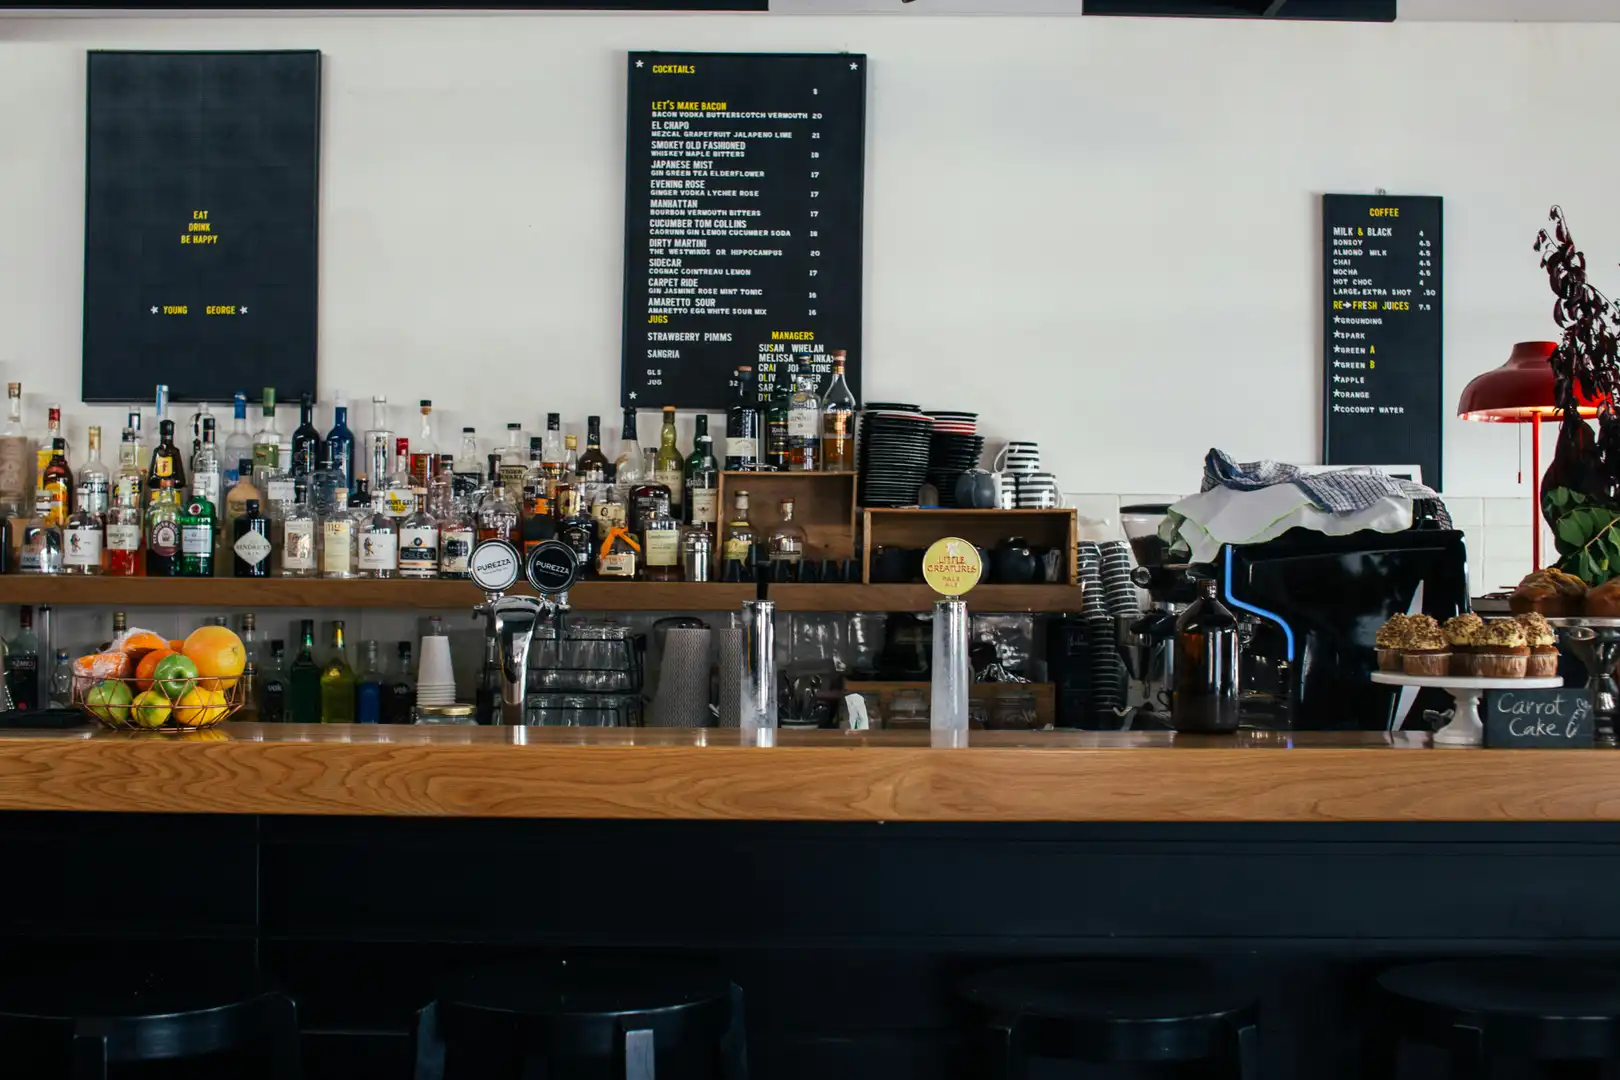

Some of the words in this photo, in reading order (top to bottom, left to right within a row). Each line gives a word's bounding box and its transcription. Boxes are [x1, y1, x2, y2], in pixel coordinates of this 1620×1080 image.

[653, 65, 695, 73] COCKTAILS
[652, 100, 674, 110] LET'S
[677, 102, 699, 110] MAKE
[701, 101, 726, 111] BACON
[652, 121, 662, 129] EL
[664, 121, 689, 129] CHAPO
[652, 141, 684, 149] SMOKEY
[686, 141, 701, 149] OLD
[703, 141, 746, 150] FASHIONED
[651, 160, 691, 169] JAPANESE
[693, 160, 713, 169] MIST
[651, 180, 683, 188] EVENING
[685, 180, 705, 189] ROSE
[650, 199, 698, 208] MANHATTAN
[194, 211, 208, 219] EAT
[1370, 208, 1399, 217] COFFEE
[189, 223, 210, 231] DRINK
[650, 219, 692, 228] CUCUMBER
[694, 219, 712, 229] TOM
[714, 220, 747, 228] COLLINS
[1333, 227, 1353, 236] MILK
[1367, 227, 1392, 237] BLACK
[181, 235, 190, 244] BE
[193, 235, 217, 244] HAPPY
[649, 239, 672, 247] DIRTY
[674, 239, 706, 248] MARTINI
[649, 258, 682, 267] SIDECAR
[648, 278, 678, 287] CARPET
[681, 278, 698, 287] RIDE
[648, 298, 690, 306] AMARETTO
[695, 298, 716, 307] SOUR
[1382, 301, 1409, 311] JUICES
[164, 306, 187, 314] YOUNG
[206, 306, 235, 314] GEORGE
[648, 315, 668, 323] JUGS
[648, 332, 700, 341] STRAWBERRY
[704, 333, 732, 341] PIMMS
[772, 331, 814, 340] MANAGERS
[759, 344, 784, 353] SUSAN
[791, 344, 824, 353] WHELAN
[648, 350, 679, 358] SANGRIA
[759, 354, 794, 362] MELISSA
[758, 364, 776, 372] CRAI
[1379, 406, 1404, 414] WATER
[476, 558, 511, 572] PUREZZA
[937, 556, 965, 565] LITTLE
[535, 560, 569, 574] PUREZZA
[927, 564, 977, 573] CREATURES
[1497, 692, 1567, 716] Carrot
[1509, 716, 1560, 737] Cake
